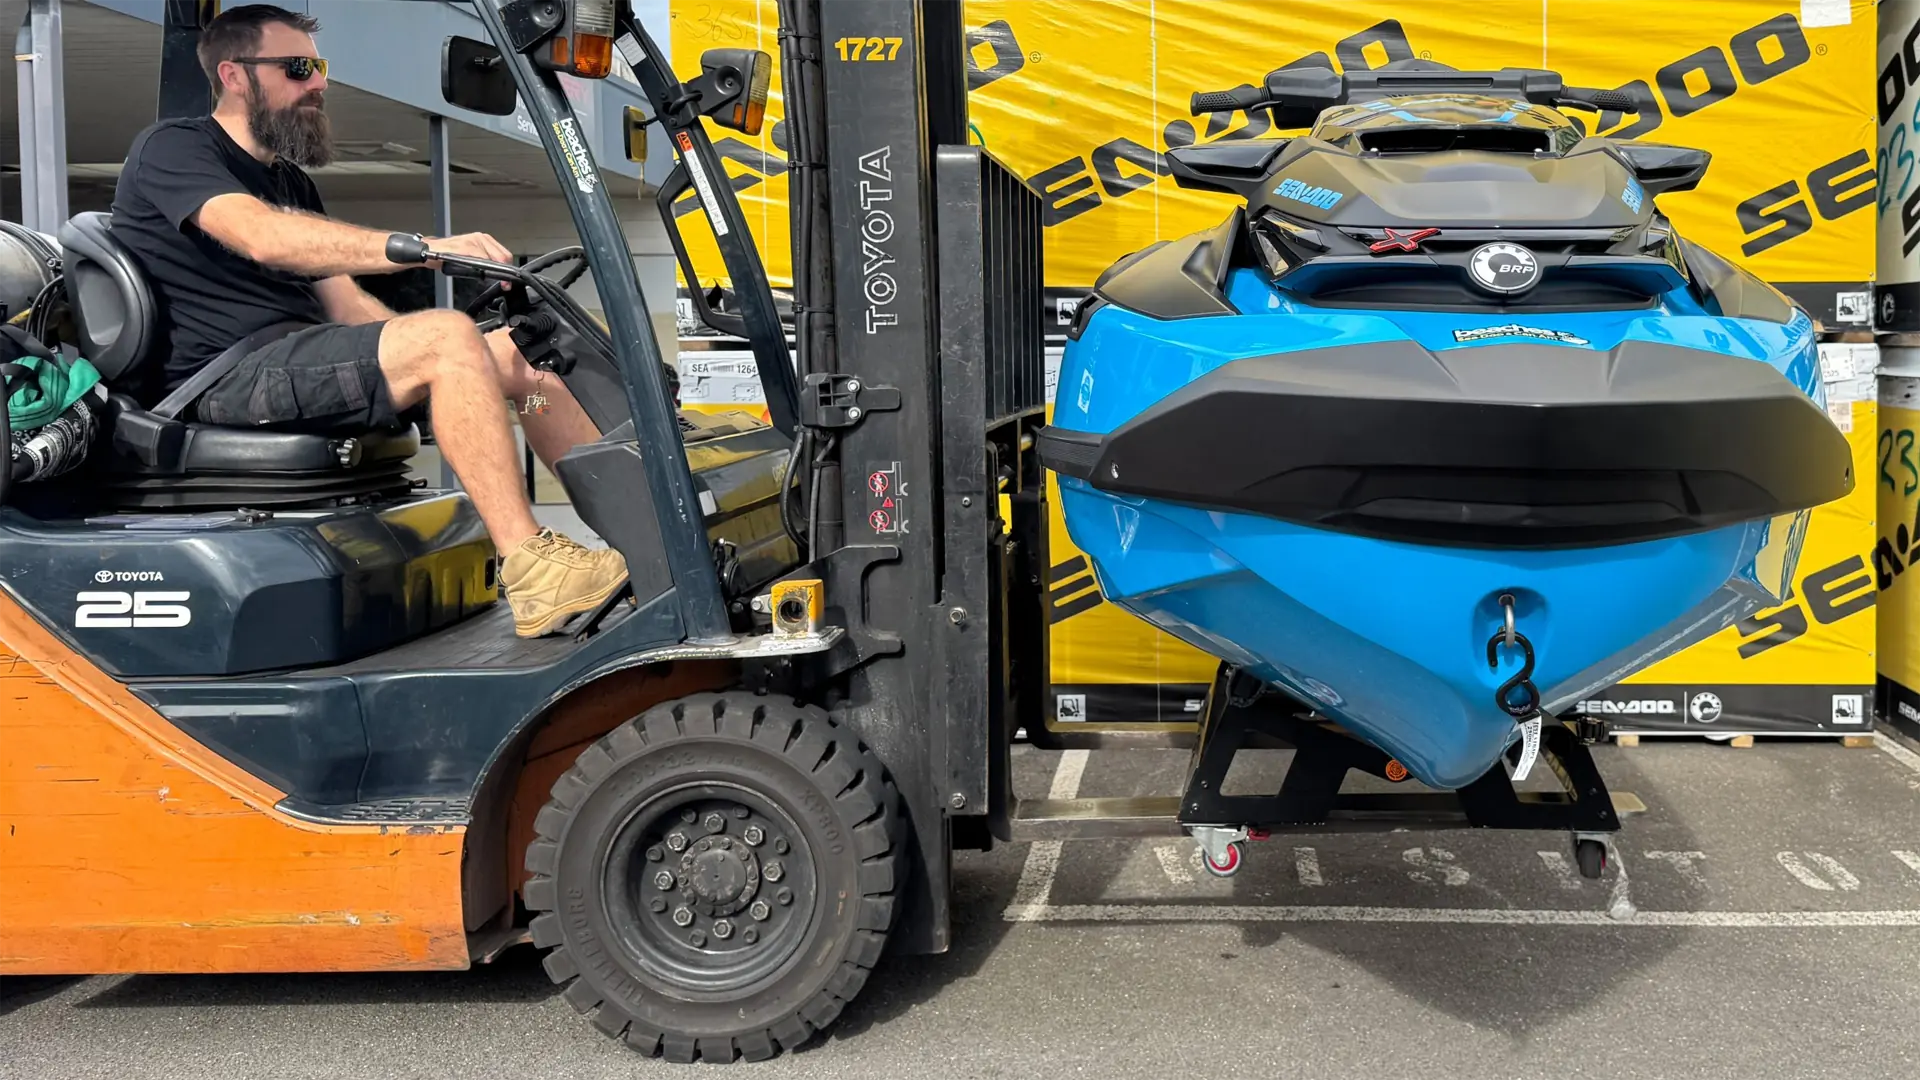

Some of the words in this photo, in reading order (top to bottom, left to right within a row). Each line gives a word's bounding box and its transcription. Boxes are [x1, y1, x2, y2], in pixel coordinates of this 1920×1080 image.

[834, 37, 903, 61] 1727
[560, 117, 592, 175] beaches
[858, 145, 898, 335] TOYOTA
[1499, 264, 1534, 274] BRP
[1454, 323, 1556, 338] beaches
[691, 363, 709, 373] SEA
[737, 364, 758, 374] 1264
[115, 571, 165, 582] TOYOTA
[75, 591, 191, 628] 25
